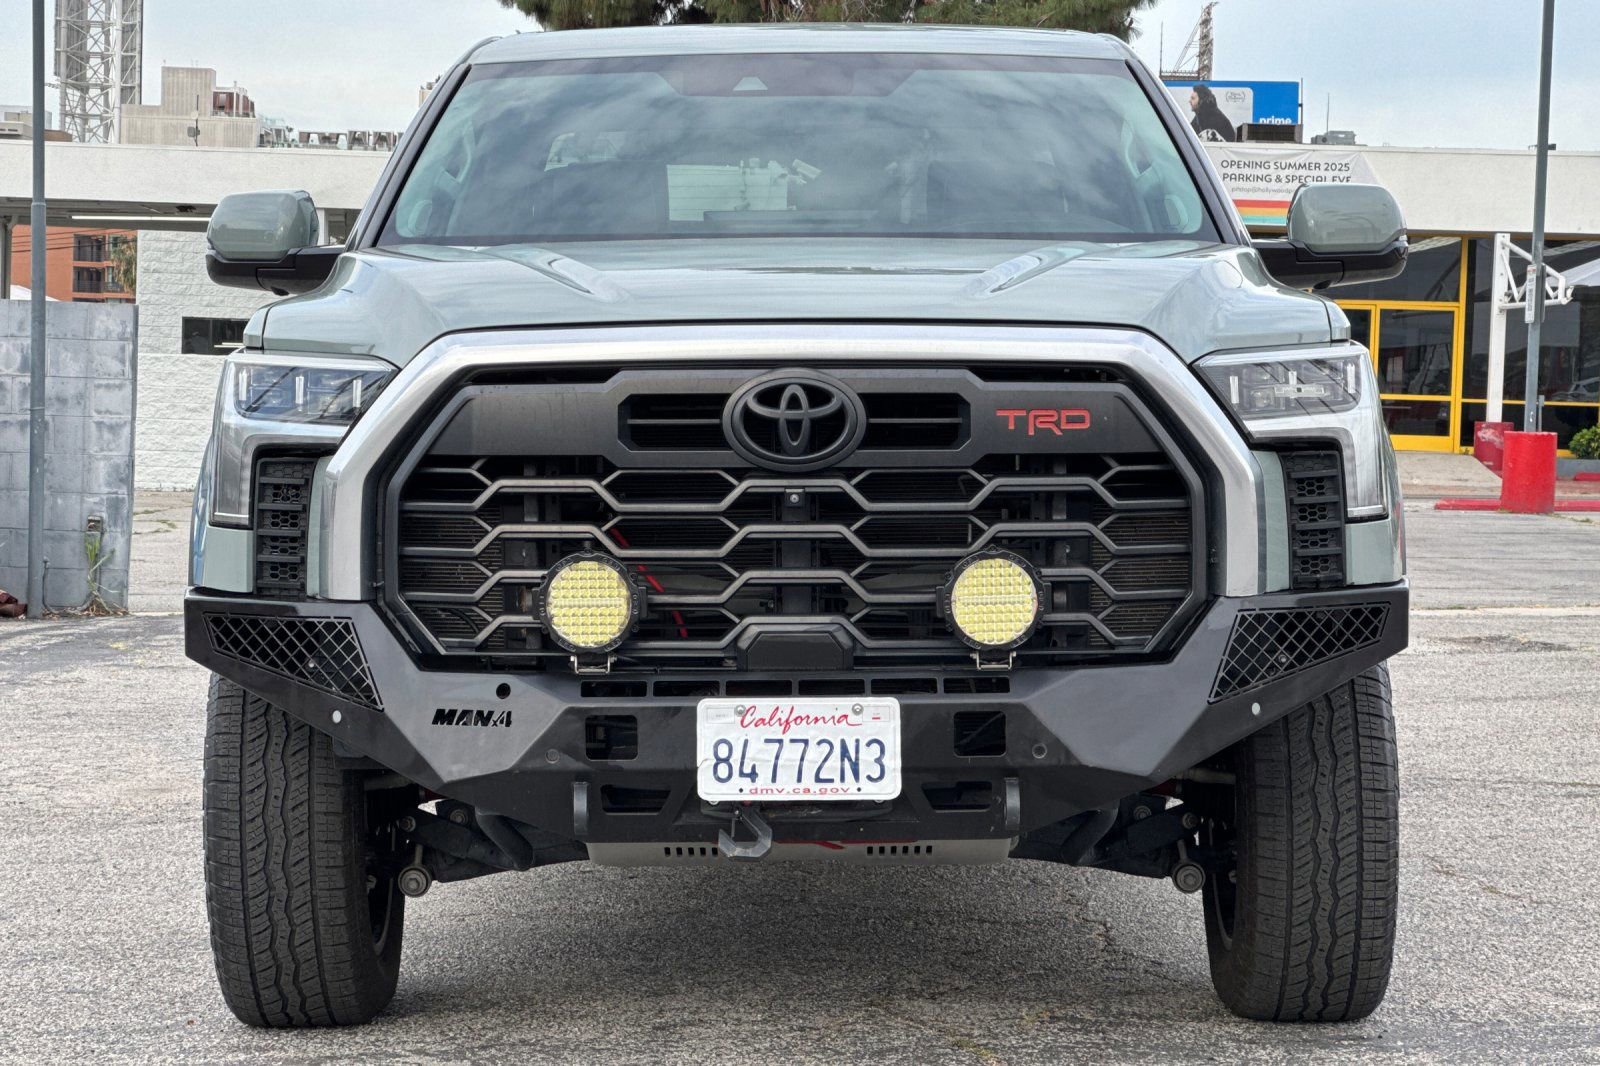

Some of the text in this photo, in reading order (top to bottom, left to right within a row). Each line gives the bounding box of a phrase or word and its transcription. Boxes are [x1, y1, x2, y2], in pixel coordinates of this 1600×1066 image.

[1220, 159, 1350, 172] OPENING SUMMER 2025
[1222, 172, 1272, 183] PARKING
[1274, 174, 1283, 183] &
[996, 408, 1091, 435] TRD
[740, 705, 862, 734] California
[712, 738, 886, 783] 84772N3
[749, 786, 850, 796] dmv.ca.gov
